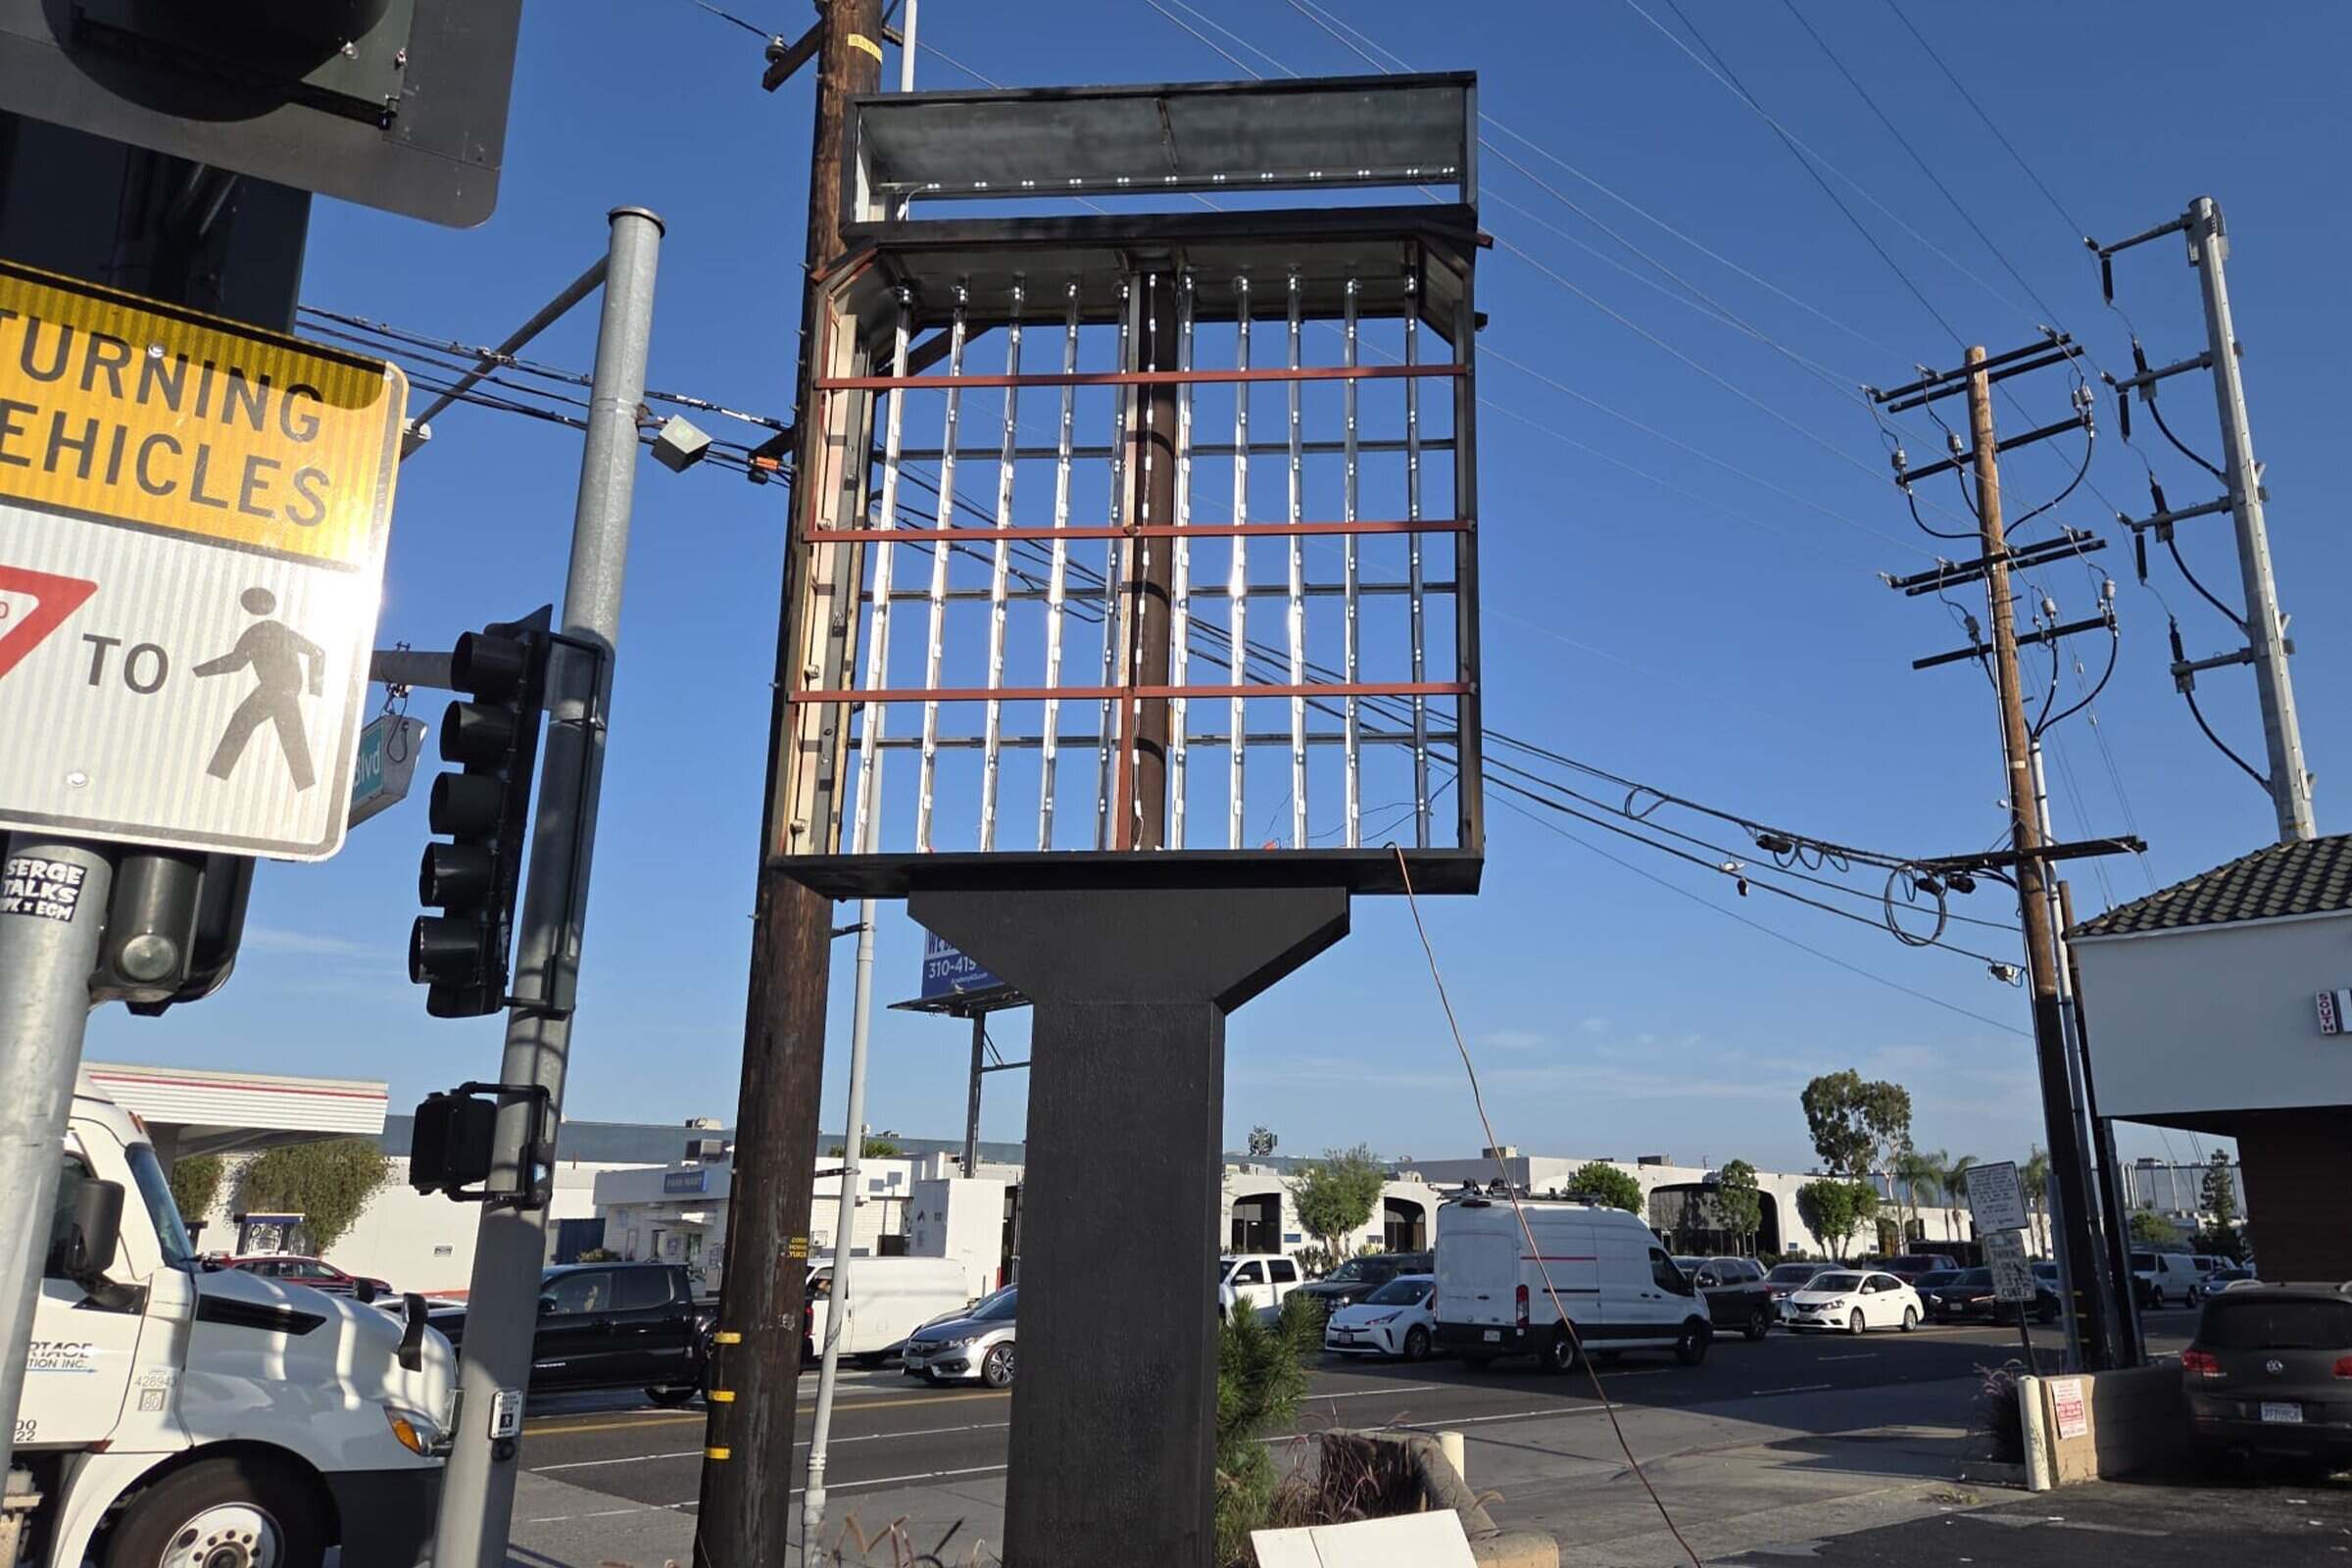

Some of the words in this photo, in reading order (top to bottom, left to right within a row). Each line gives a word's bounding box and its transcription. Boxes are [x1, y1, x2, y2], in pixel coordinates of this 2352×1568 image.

[82, 633, 169, 695] TO
[7, 858, 84, 884] SERGE
[4, 879, 78, 903] TALKS
[2319, 993, 2333, 1032] SOUTH
